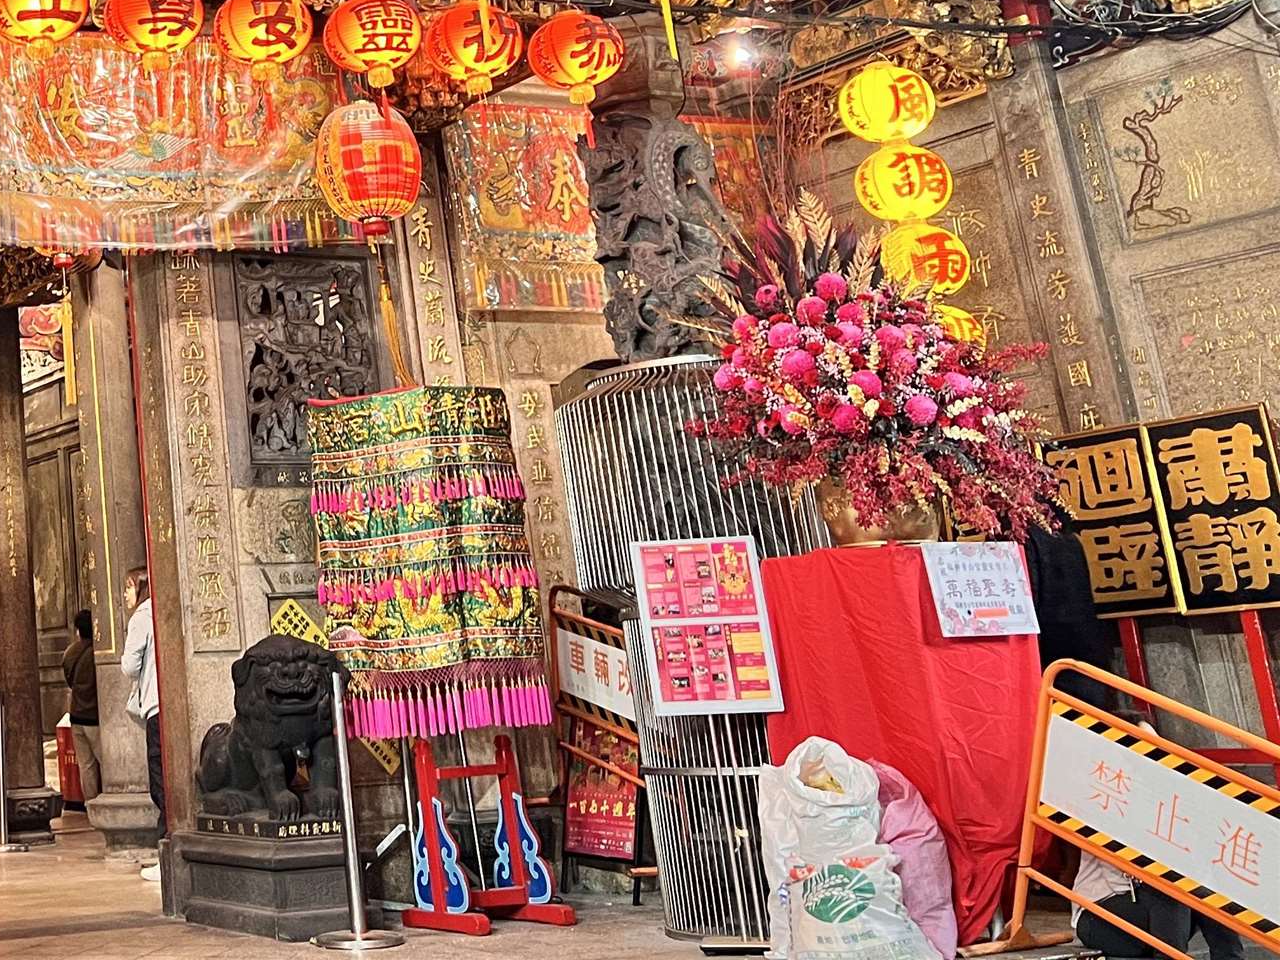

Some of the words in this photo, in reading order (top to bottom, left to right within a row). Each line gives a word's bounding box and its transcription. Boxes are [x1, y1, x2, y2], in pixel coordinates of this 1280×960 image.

[349, 1, 413, 53] 靈
[463, 9, 518, 65] 祝
[570, 19, 624, 71] 恭
[888, 75, 927, 123] 風
[547, 149, 589, 222] 泰
[886, 153, 948, 203] 調
[911, 233, 969, 284] 雨
[1158, 422, 1280, 595] 肅靜
[1090, 760, 1264, 887] 禁止進
